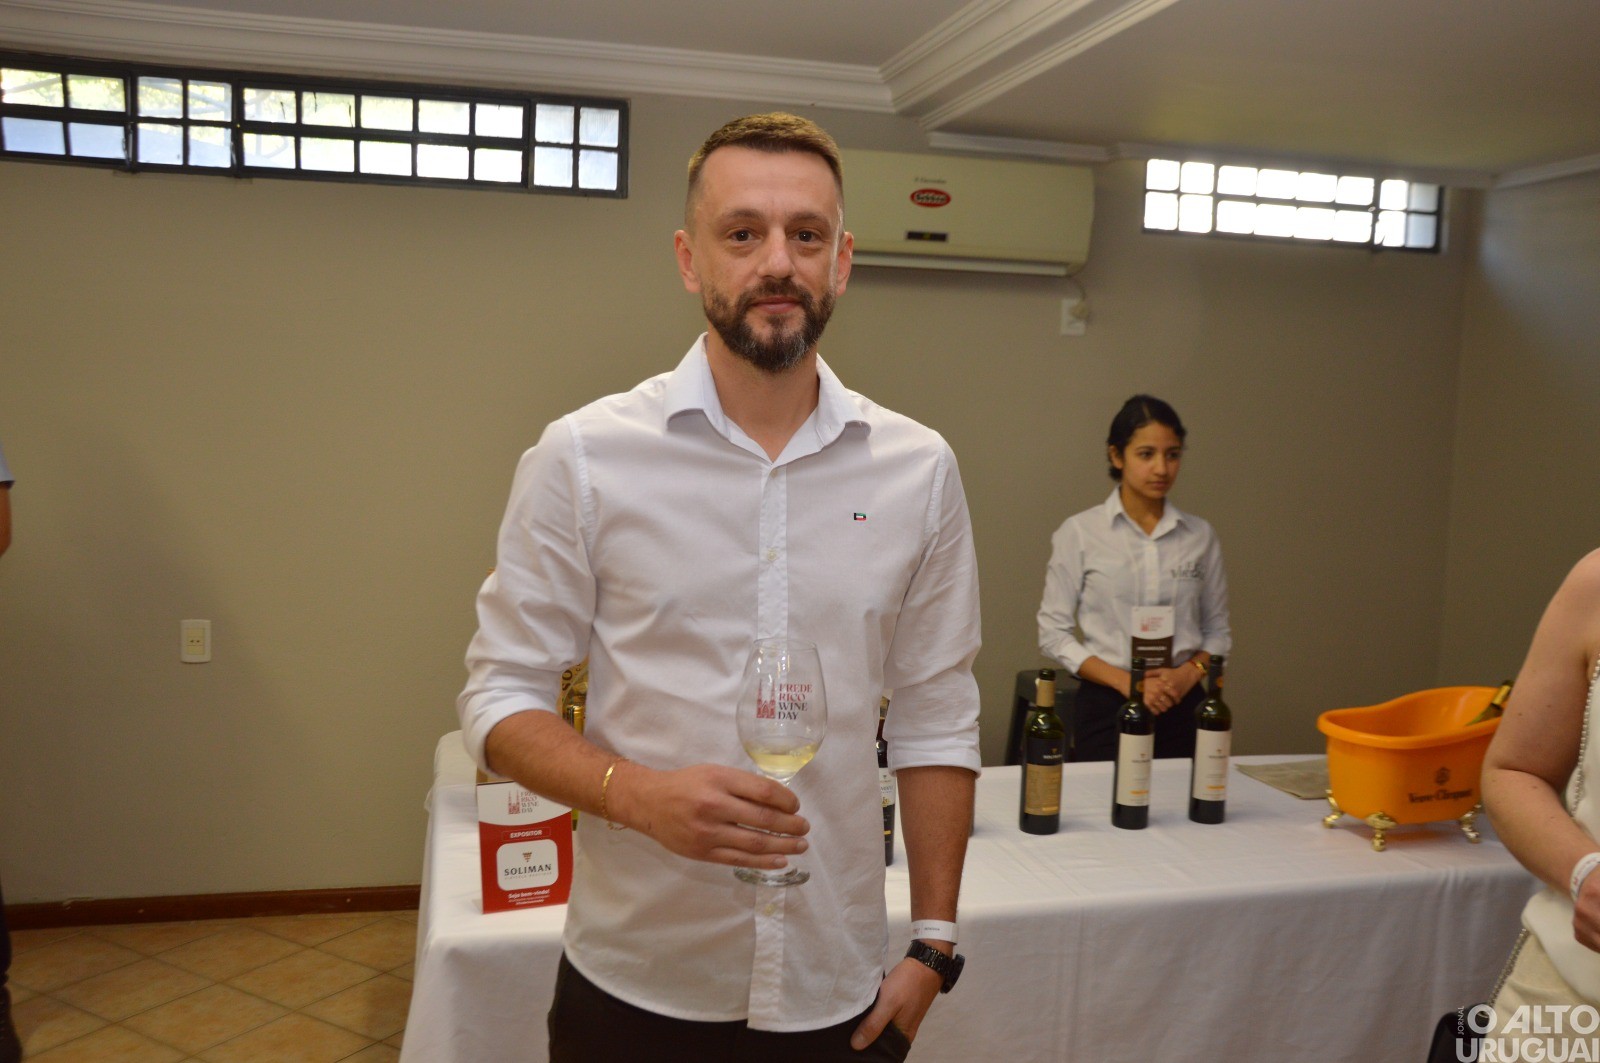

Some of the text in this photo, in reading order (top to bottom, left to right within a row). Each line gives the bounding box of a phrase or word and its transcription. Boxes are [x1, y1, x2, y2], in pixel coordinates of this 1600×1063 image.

[779, 683, 813, 692] FREDE
[779, 693, 806, 702] RICO
[778, 702, 808, 711] WINE
[778, 711, 799, 720] DAY
[510, 829, 542, 838] EXPOSITOR
[504, 864, 552, 876] SOLIMAN
